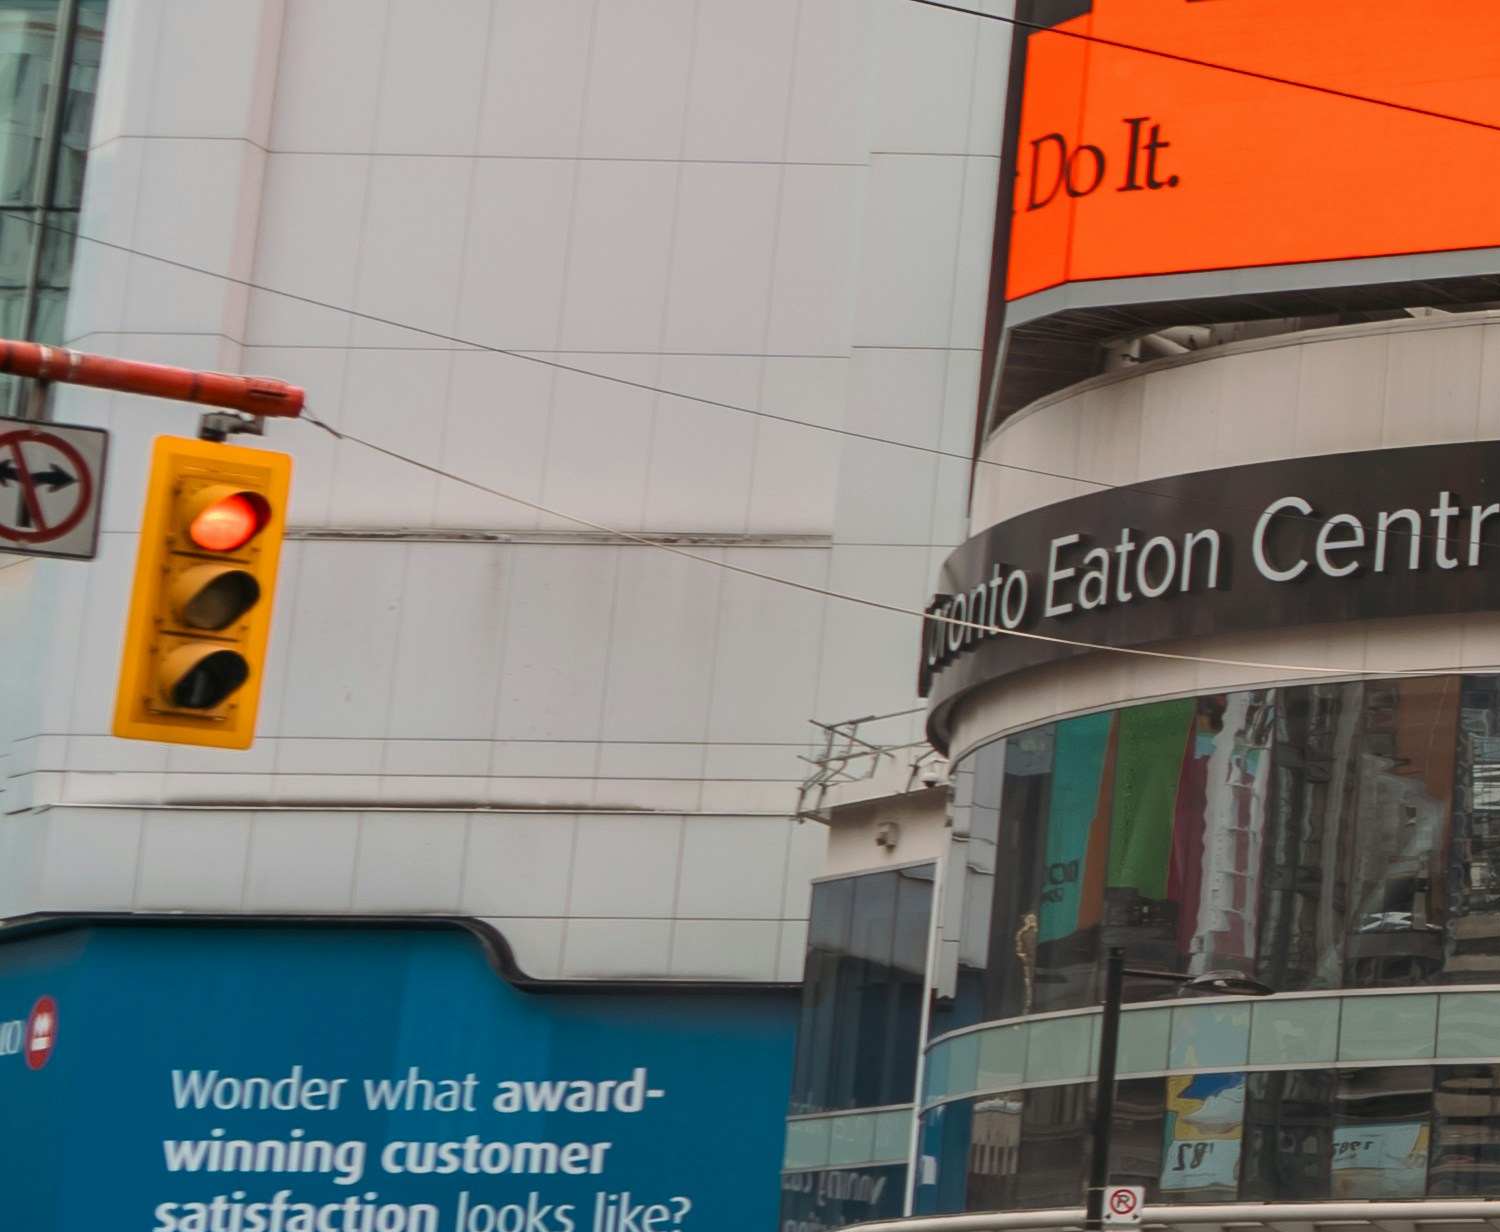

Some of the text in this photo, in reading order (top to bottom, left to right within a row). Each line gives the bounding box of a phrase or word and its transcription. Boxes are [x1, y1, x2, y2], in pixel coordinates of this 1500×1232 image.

[1026, 116, 1180, 213] Do It.
[1044, 527, 1221, 618] Eaton
[171, 1064, 666, 1114] Wonder what award-
[162, 1127, 613, 1186] winning customer
